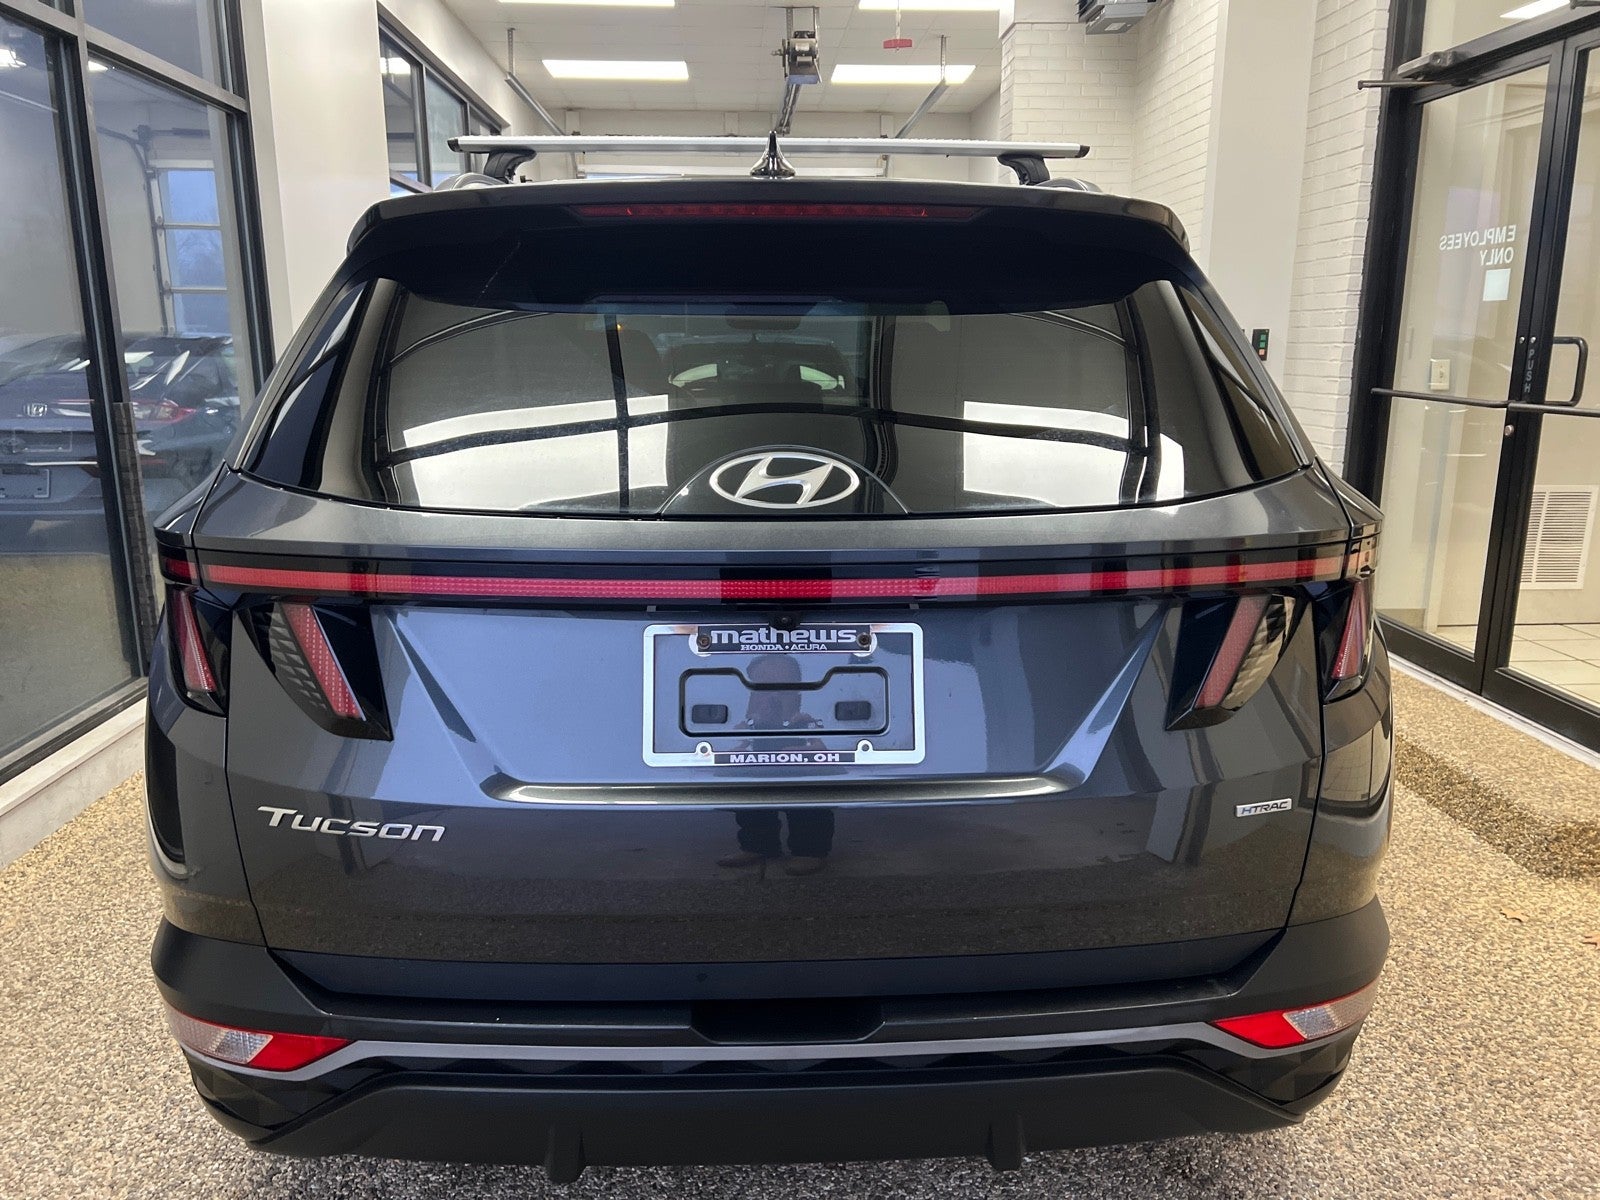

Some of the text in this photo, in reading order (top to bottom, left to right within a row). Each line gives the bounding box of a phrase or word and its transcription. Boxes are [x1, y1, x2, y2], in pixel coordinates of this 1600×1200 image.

[1523, 348, 1535, 393] PUSH
[710, 626, 857, 644] mathews
[790, 643, 828, 651] ACURA
[729, 752, 840, 763] MARION, OH
[1240, 801, 1289, 815] HTRAC
